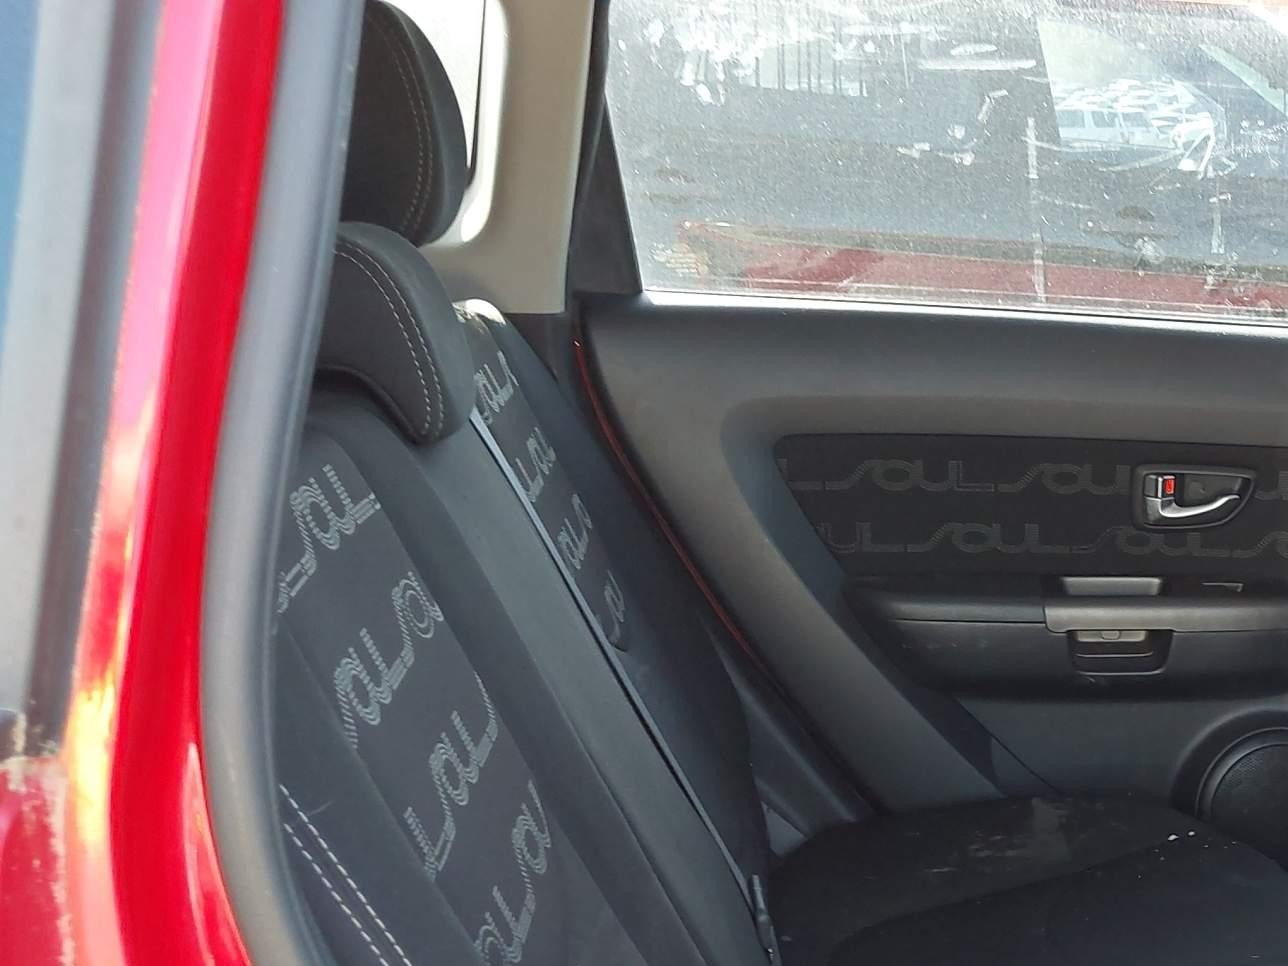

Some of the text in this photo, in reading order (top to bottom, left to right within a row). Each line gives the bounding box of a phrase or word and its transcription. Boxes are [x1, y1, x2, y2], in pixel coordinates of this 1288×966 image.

[824, 459, 996, 493] SOUL
[905, 521, 1071, 554] SOUL
[1070, 526, 1232, 558] SOUL
